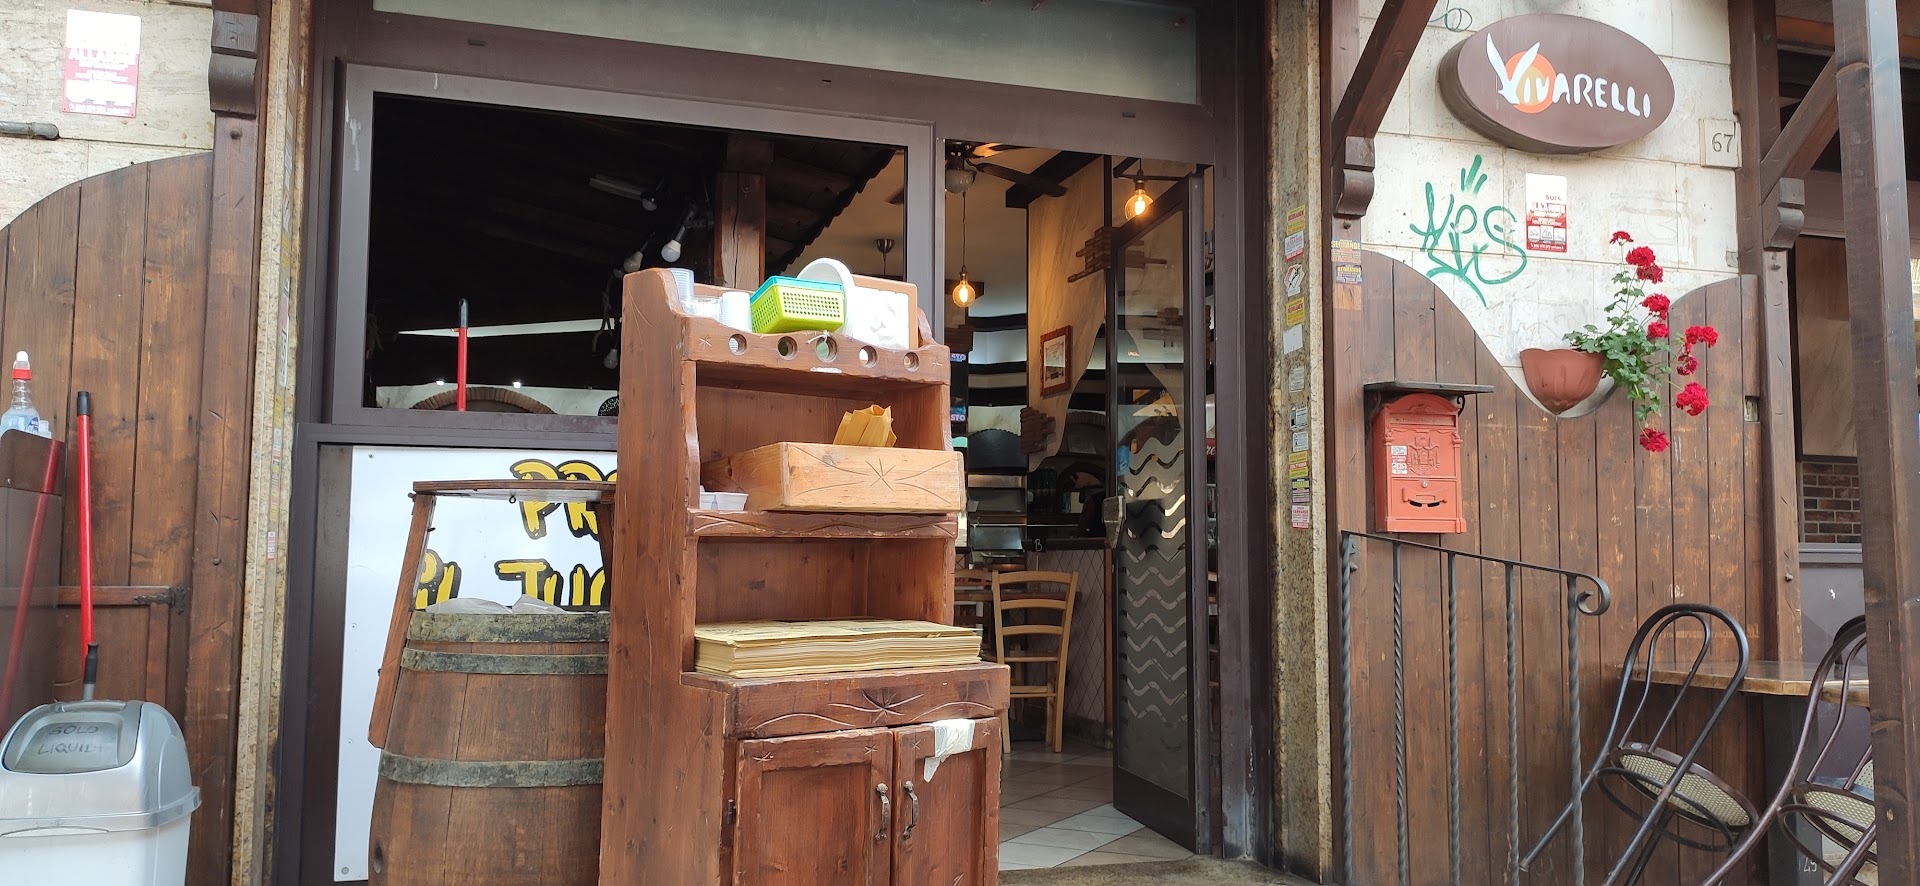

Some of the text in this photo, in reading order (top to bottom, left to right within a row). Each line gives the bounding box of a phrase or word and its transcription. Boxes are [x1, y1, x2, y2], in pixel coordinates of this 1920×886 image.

[1486, 32, 1651, 119] VIVARELLI
[1711, 132, 1734, 152] 67
[511, 459, 617, 541] PR
